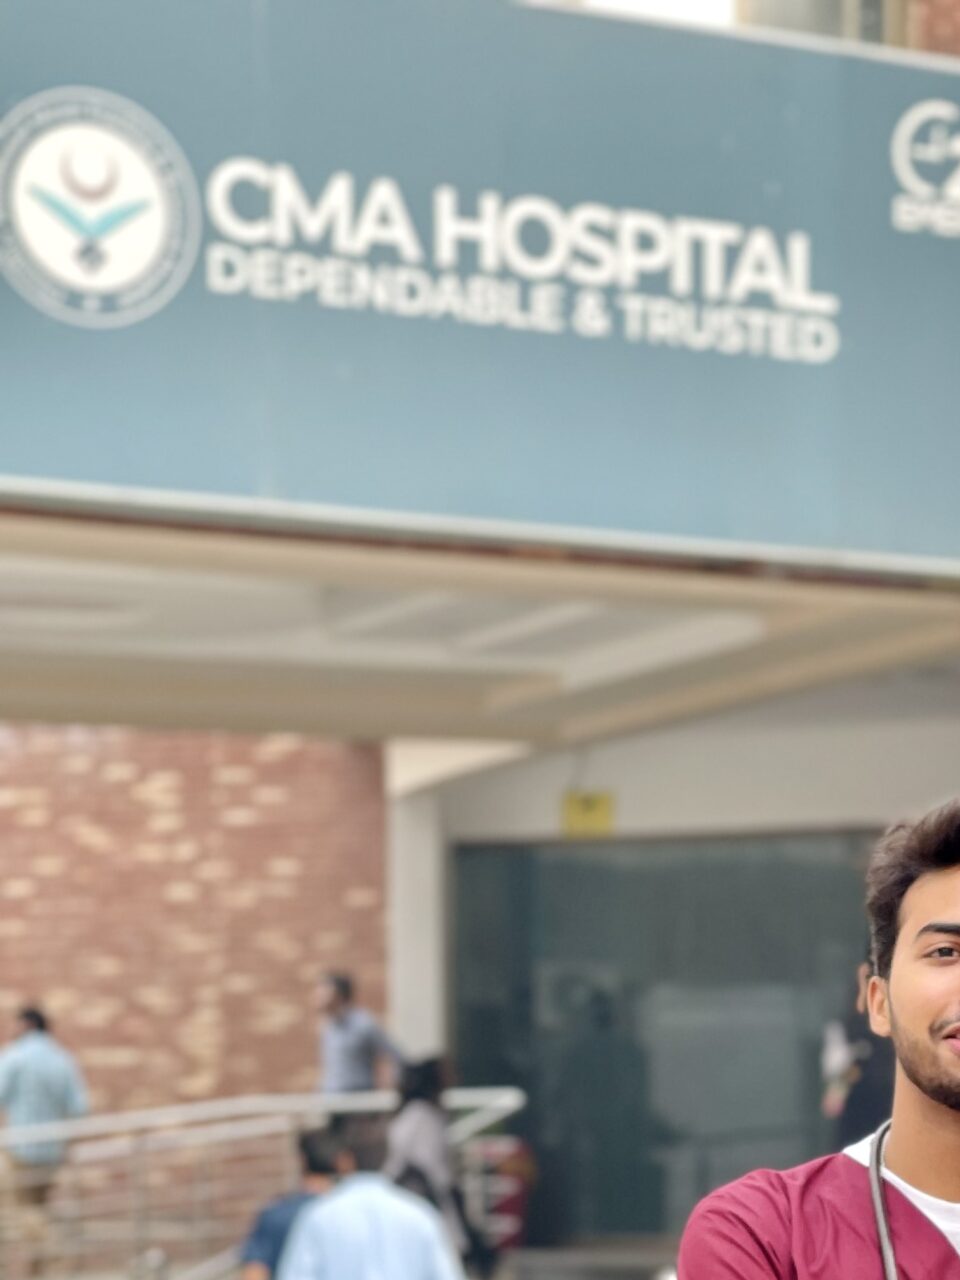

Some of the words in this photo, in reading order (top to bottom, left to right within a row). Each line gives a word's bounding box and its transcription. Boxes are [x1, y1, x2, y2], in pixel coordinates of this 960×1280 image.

[205, 242, 566, 333] DEPENDABLE
[571, 288, 612, 338] &
[616, 290, 840, 362] TRUSTED
[206, 156, 423, 263] CMA
[432, 184, 840, 316] HOSPITAL
